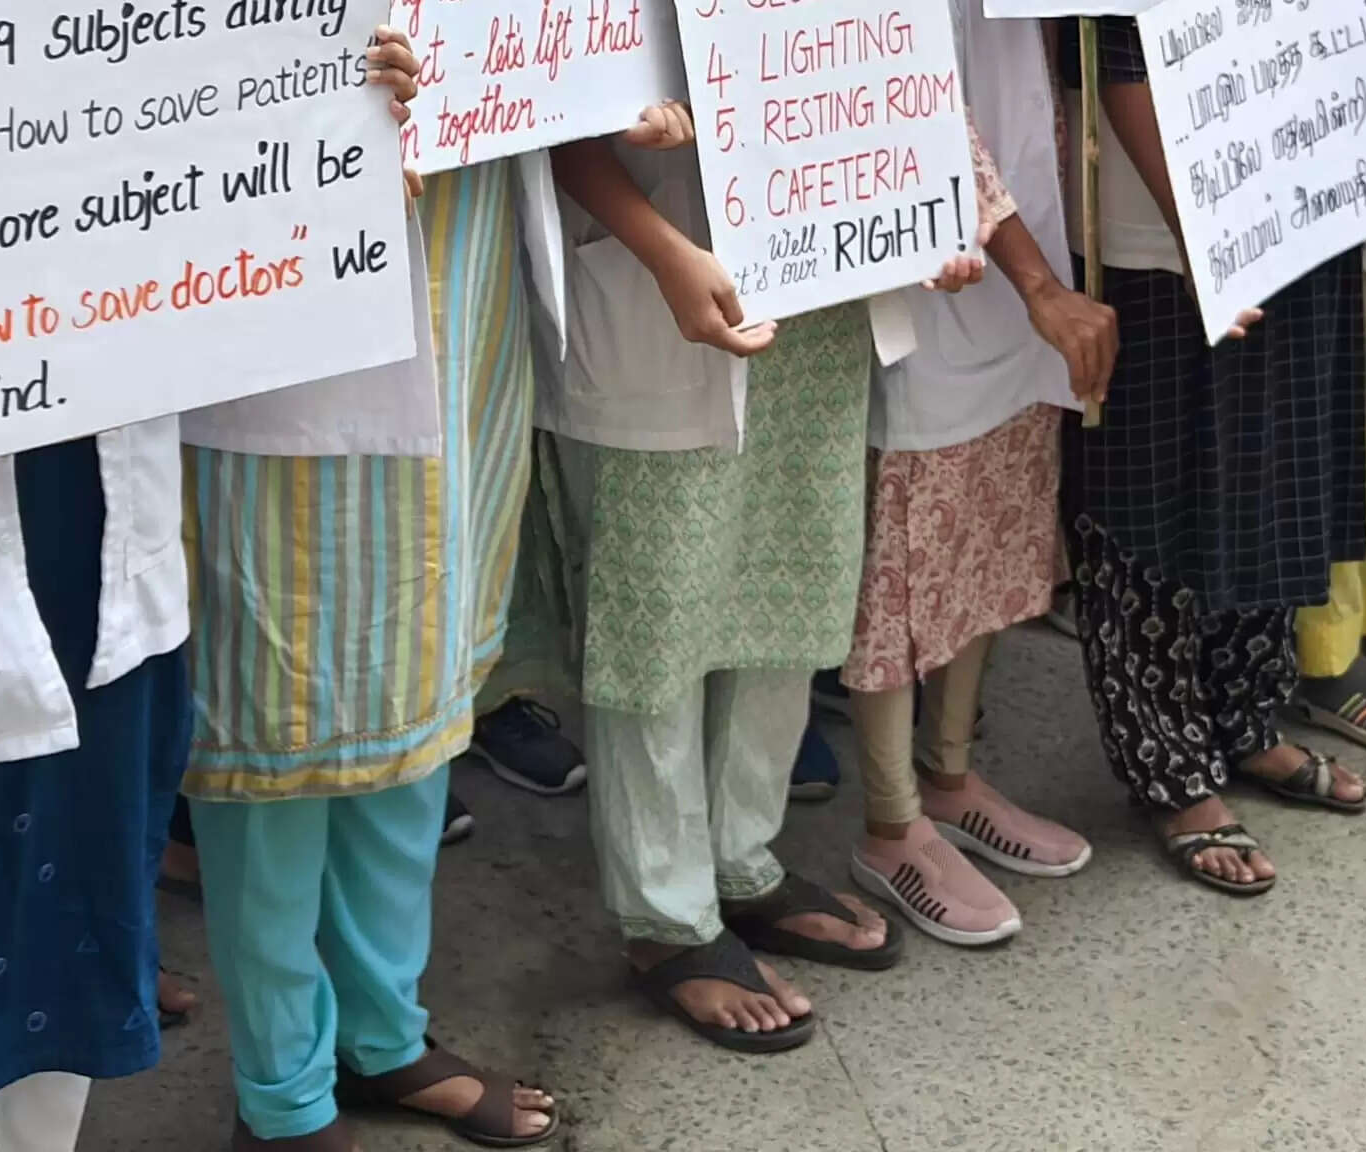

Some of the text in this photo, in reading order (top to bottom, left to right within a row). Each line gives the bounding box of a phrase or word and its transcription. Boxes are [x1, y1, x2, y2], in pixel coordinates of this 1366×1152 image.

[532, 4, 575, 82] lift
[761, 11, 914, 83] LIGHTING
[81, 99, 123, 139] to
[134, 83, 220, 131] save
[716, 70, 955, 153] 5. RESTING ROOM
[74, 164, 205, 232] subject
[222, 140, 293, 204] will
[316, 138, 364, 189] be
[725, 146, 921, 227] 6. CAFETERIA
[20, 294, 60, 337] to
